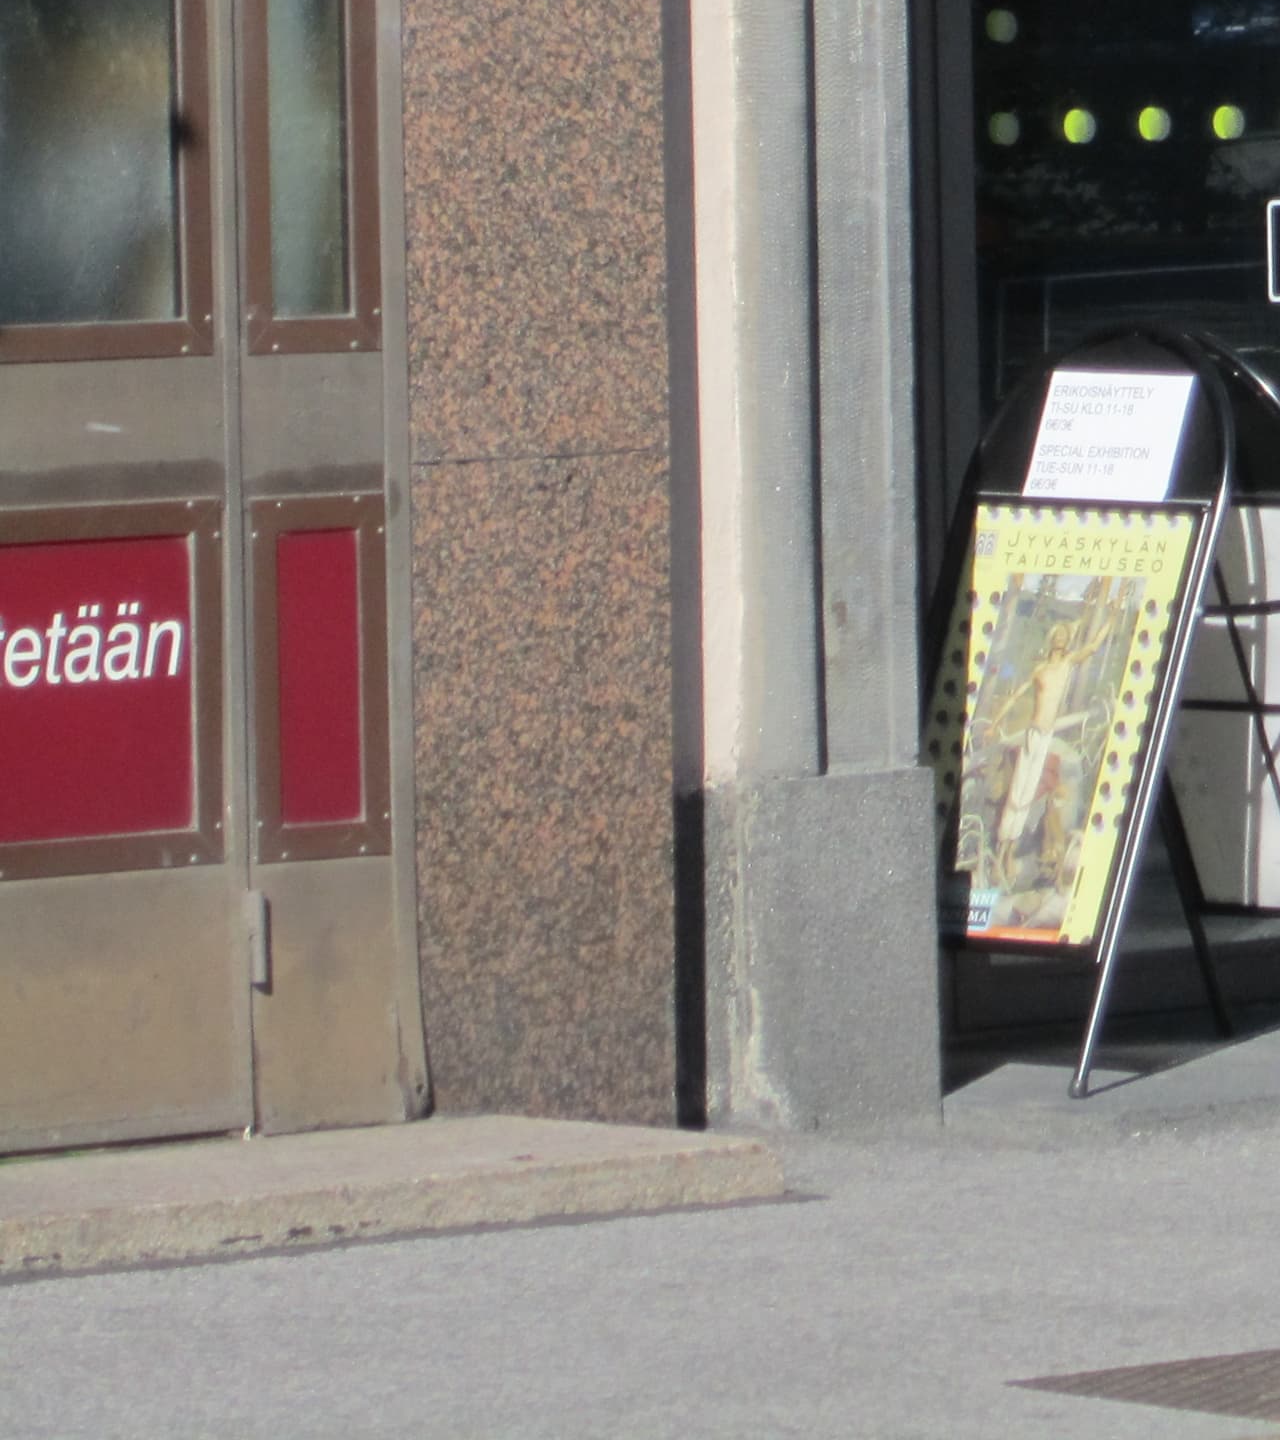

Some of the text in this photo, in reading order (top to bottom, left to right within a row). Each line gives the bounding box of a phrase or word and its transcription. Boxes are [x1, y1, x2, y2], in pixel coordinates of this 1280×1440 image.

[1052, 384, 1155, 400] ERIKOISNÄYTTELY
[1080, 402, 1104, 416] KLO
[1105, 402, 1136, 417] 11-18
[1038, 444, 1151, 460] SPECIAL EXHIBITION
[1034, 461, 1115, 477] TUE-SUN 11-18
[1007, 530, 1168, 553] JYVÄSKYLÄN
[1004, 552, 1164, 573] TAIDEMUSEO
[0, 601, 183, 688] etään
